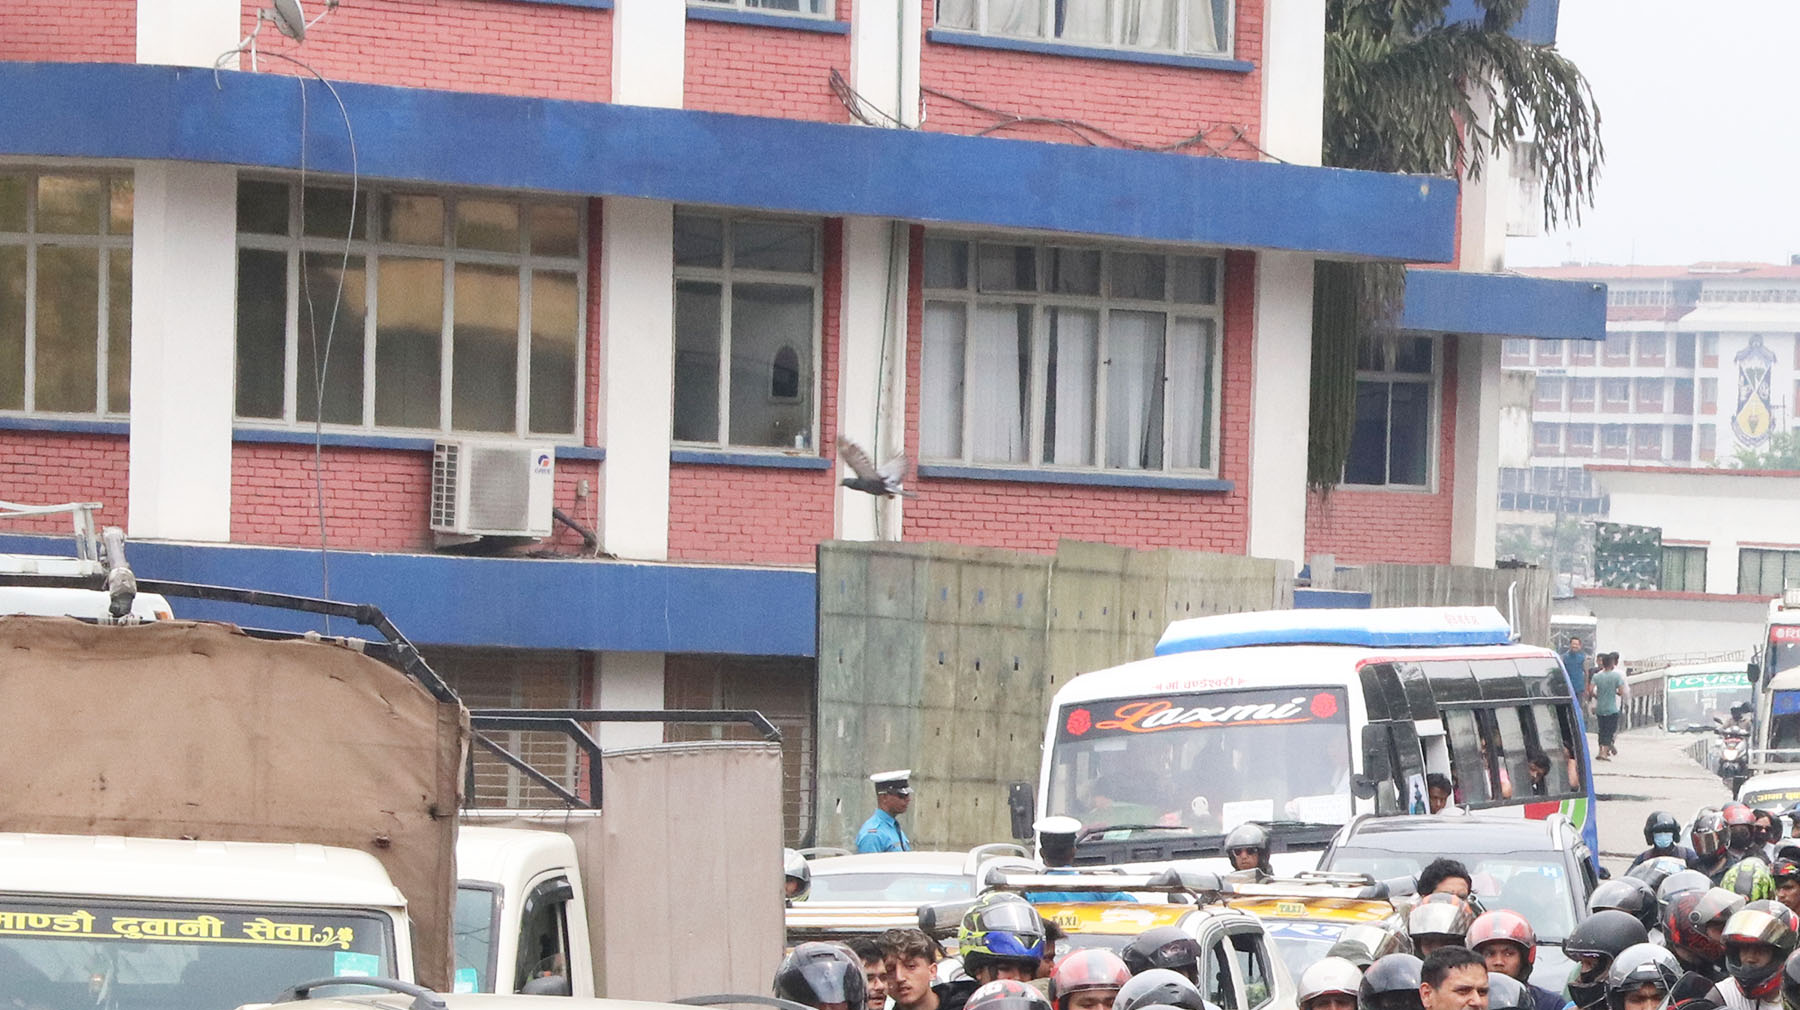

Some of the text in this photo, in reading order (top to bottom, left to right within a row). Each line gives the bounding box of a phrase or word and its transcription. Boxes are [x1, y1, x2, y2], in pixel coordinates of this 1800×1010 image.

[1096, 696, 1313, 733] Laxmi
[1279, 904, 1302, 913] TAXI
[243, 917, 315, 941] सेवा
[1052, 915, 1078, 926] TAXI
